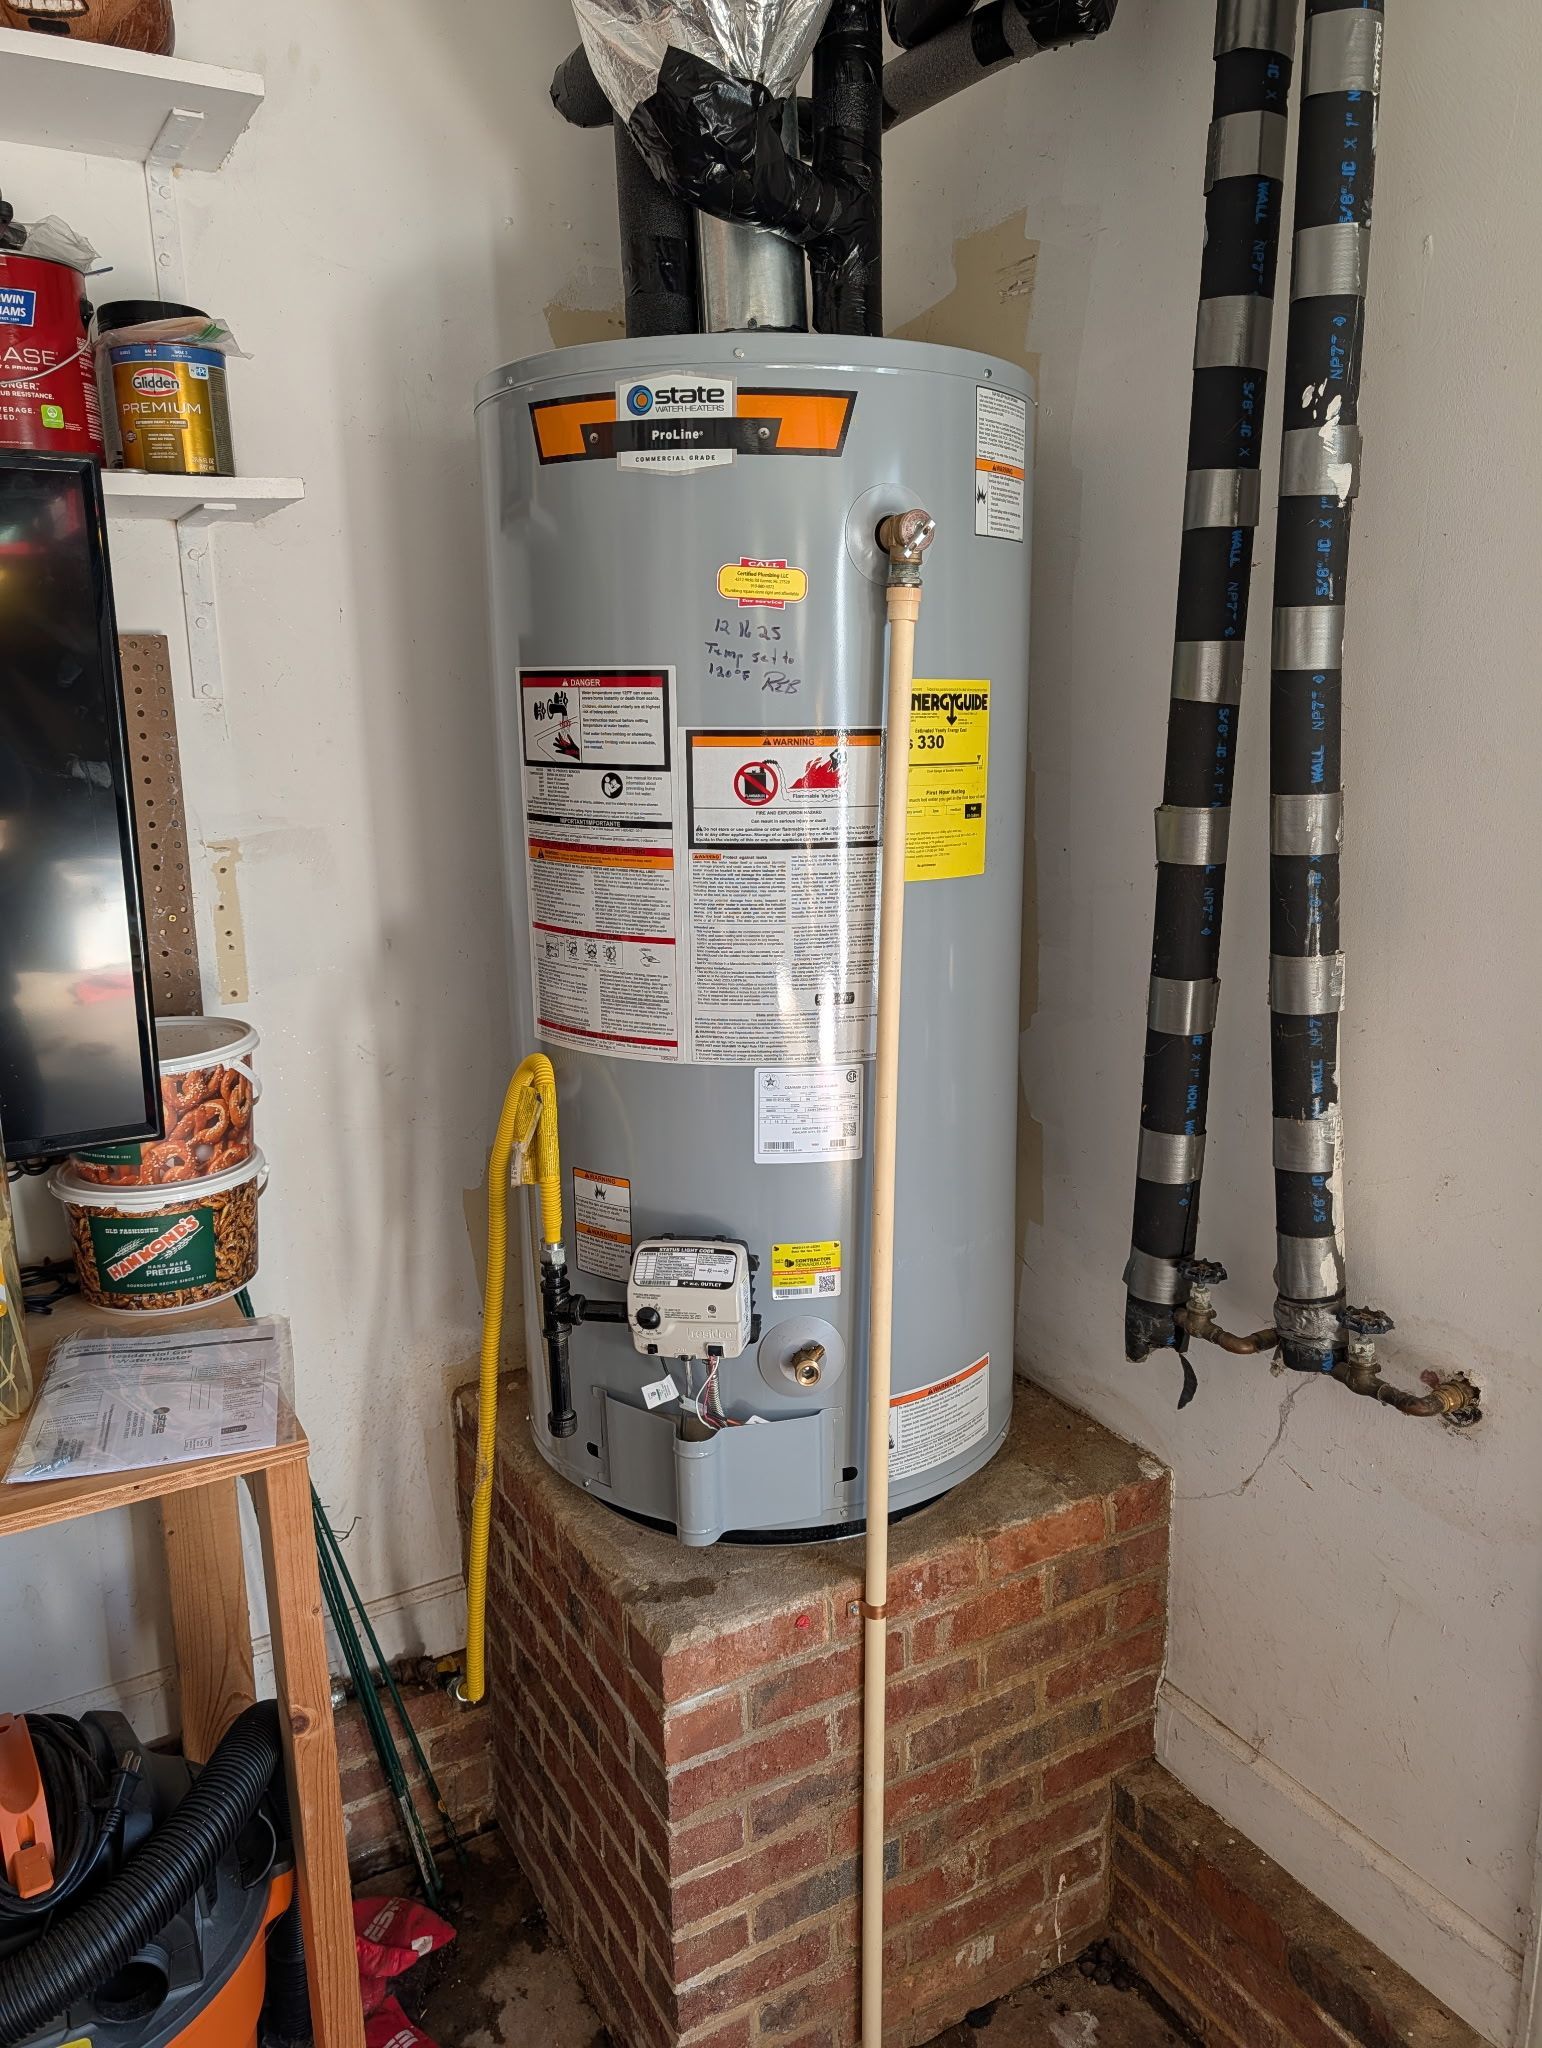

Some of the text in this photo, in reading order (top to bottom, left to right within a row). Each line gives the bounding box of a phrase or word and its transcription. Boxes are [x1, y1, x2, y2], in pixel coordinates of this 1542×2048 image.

[1345, 112, 1360, 127] 1"
[1343, 137, 1358, 149] X
[1255, 181, 1270, 225] WALL
[133, 376, 180, 389] Glidden
[12, 390, 54, 400] RESISTANCE.
[655, 386, 725, 404] state
[123, 402, 201, 414] PREMIUM
[684, 404, 725, 412] HEATERS
[1239, 448, 1250, 456] X
[1318, 518, 1334, 529] X
[1229, 529, 1242, 568] WALL
[715, 619, 730, 635] 12
[757, 626, 781, 640] 25
[705, 642, 794, 668] Temp set to
[911, 693, 988, 711] NERGYGUIDE
[773, 738, 814, 746] WARNING
[918, 735, 944, 749] 330
[1215, 766, 1224, 774] X
[1310, 744, 1325, 784] WALL
[1311, 1059, 1324, 1095] WALL
[1185, 1084, 1198, 1114] NOM.
[590, 1174, 616, 1184] WARNING
[591, 1228, 617, 1240] WARNING
[107, 1215, 200, 1281] HAMMOND'S
[146, 1264, 192, 1276] PRETZELS
[108, 1350, 170, 1359] Residential
